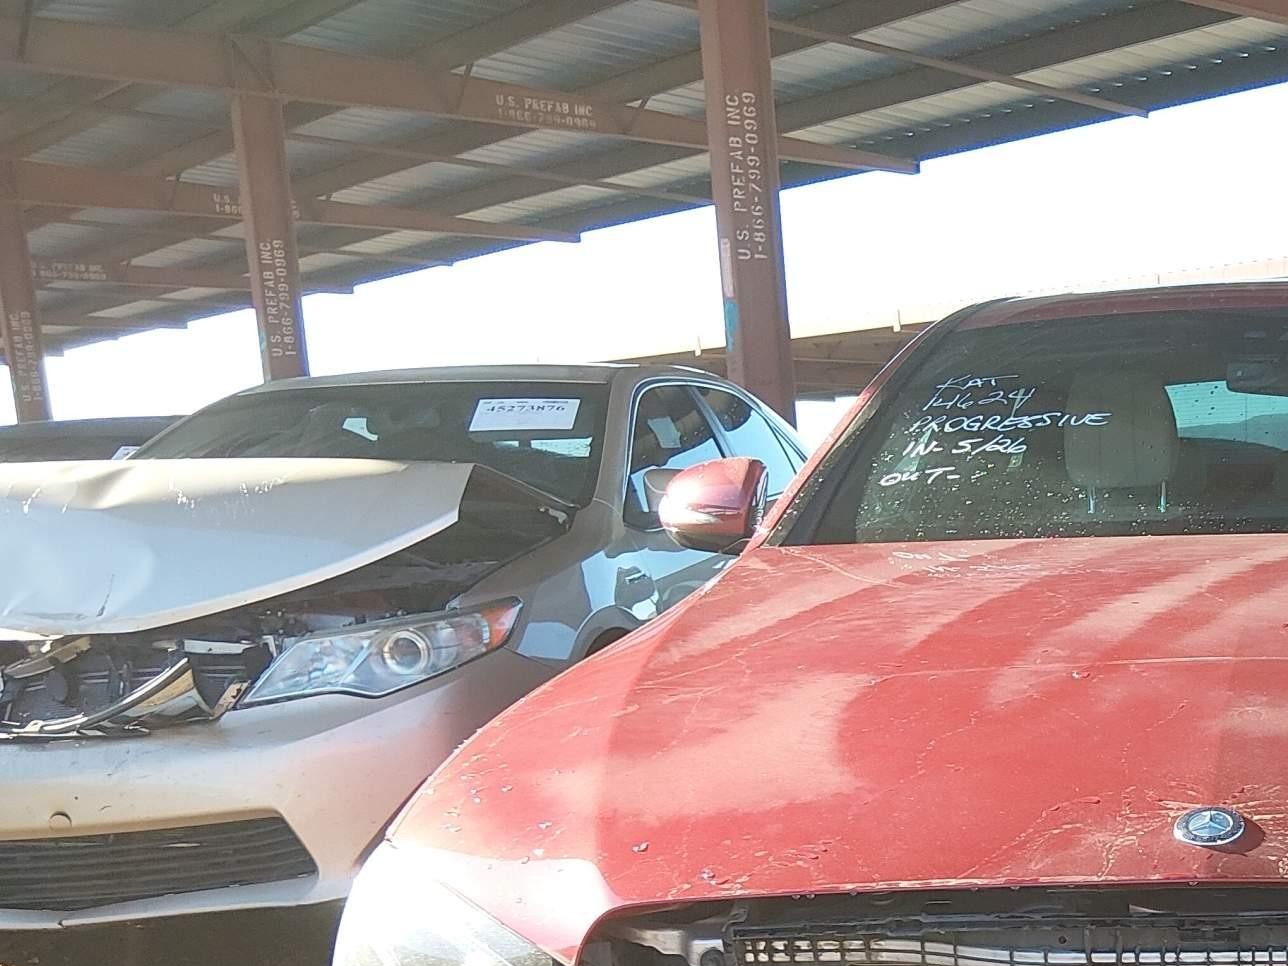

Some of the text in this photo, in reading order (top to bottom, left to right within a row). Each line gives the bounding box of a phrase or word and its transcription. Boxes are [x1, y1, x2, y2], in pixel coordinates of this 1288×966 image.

[524, 98, 569, 114] PREFAB
[726, 94, 751, 260] U.S. PREFAB INC
[741, 92, 768, 259] 1-866-799-0969
[263, 271, 280, 324] PREFAB
[273, 240, 297, 355] 1-866-799-0969
[908, 412, 1112, 432] PROGRESSIVE
